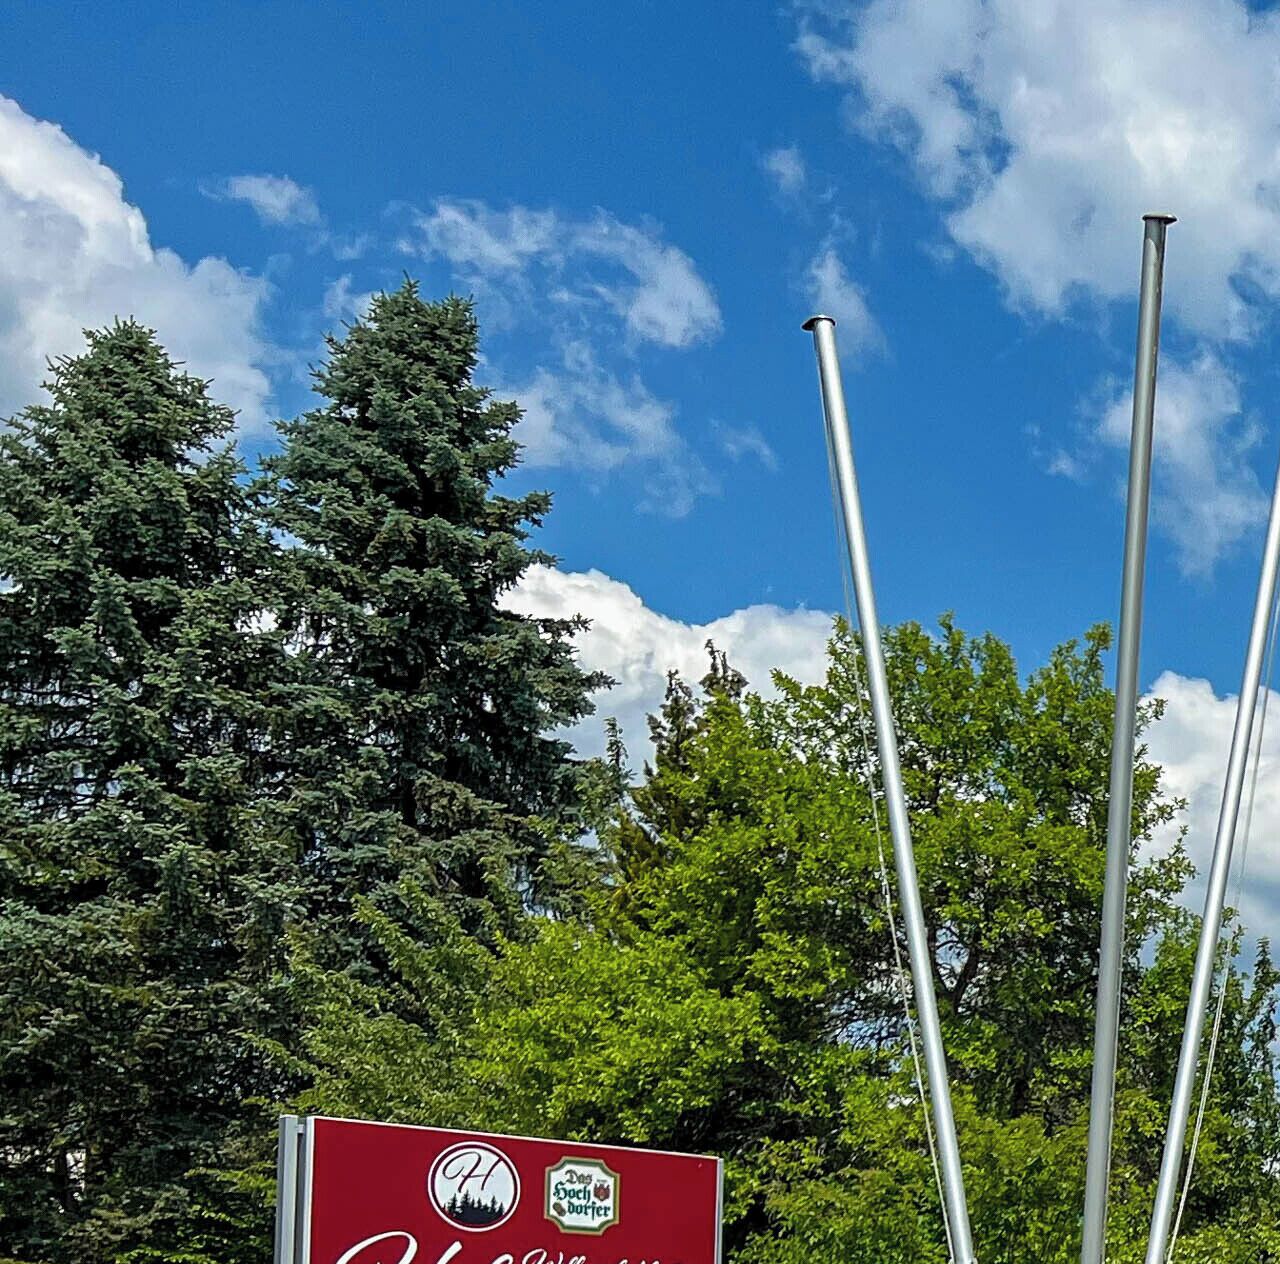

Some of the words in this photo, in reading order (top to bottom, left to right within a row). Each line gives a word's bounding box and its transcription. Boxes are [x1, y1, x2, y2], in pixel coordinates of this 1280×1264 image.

[565, 1169, 593, 1185] Das
[553, 1180, 591, 1204] Hoch
[567, 1200, 611, 1221] dorfer
